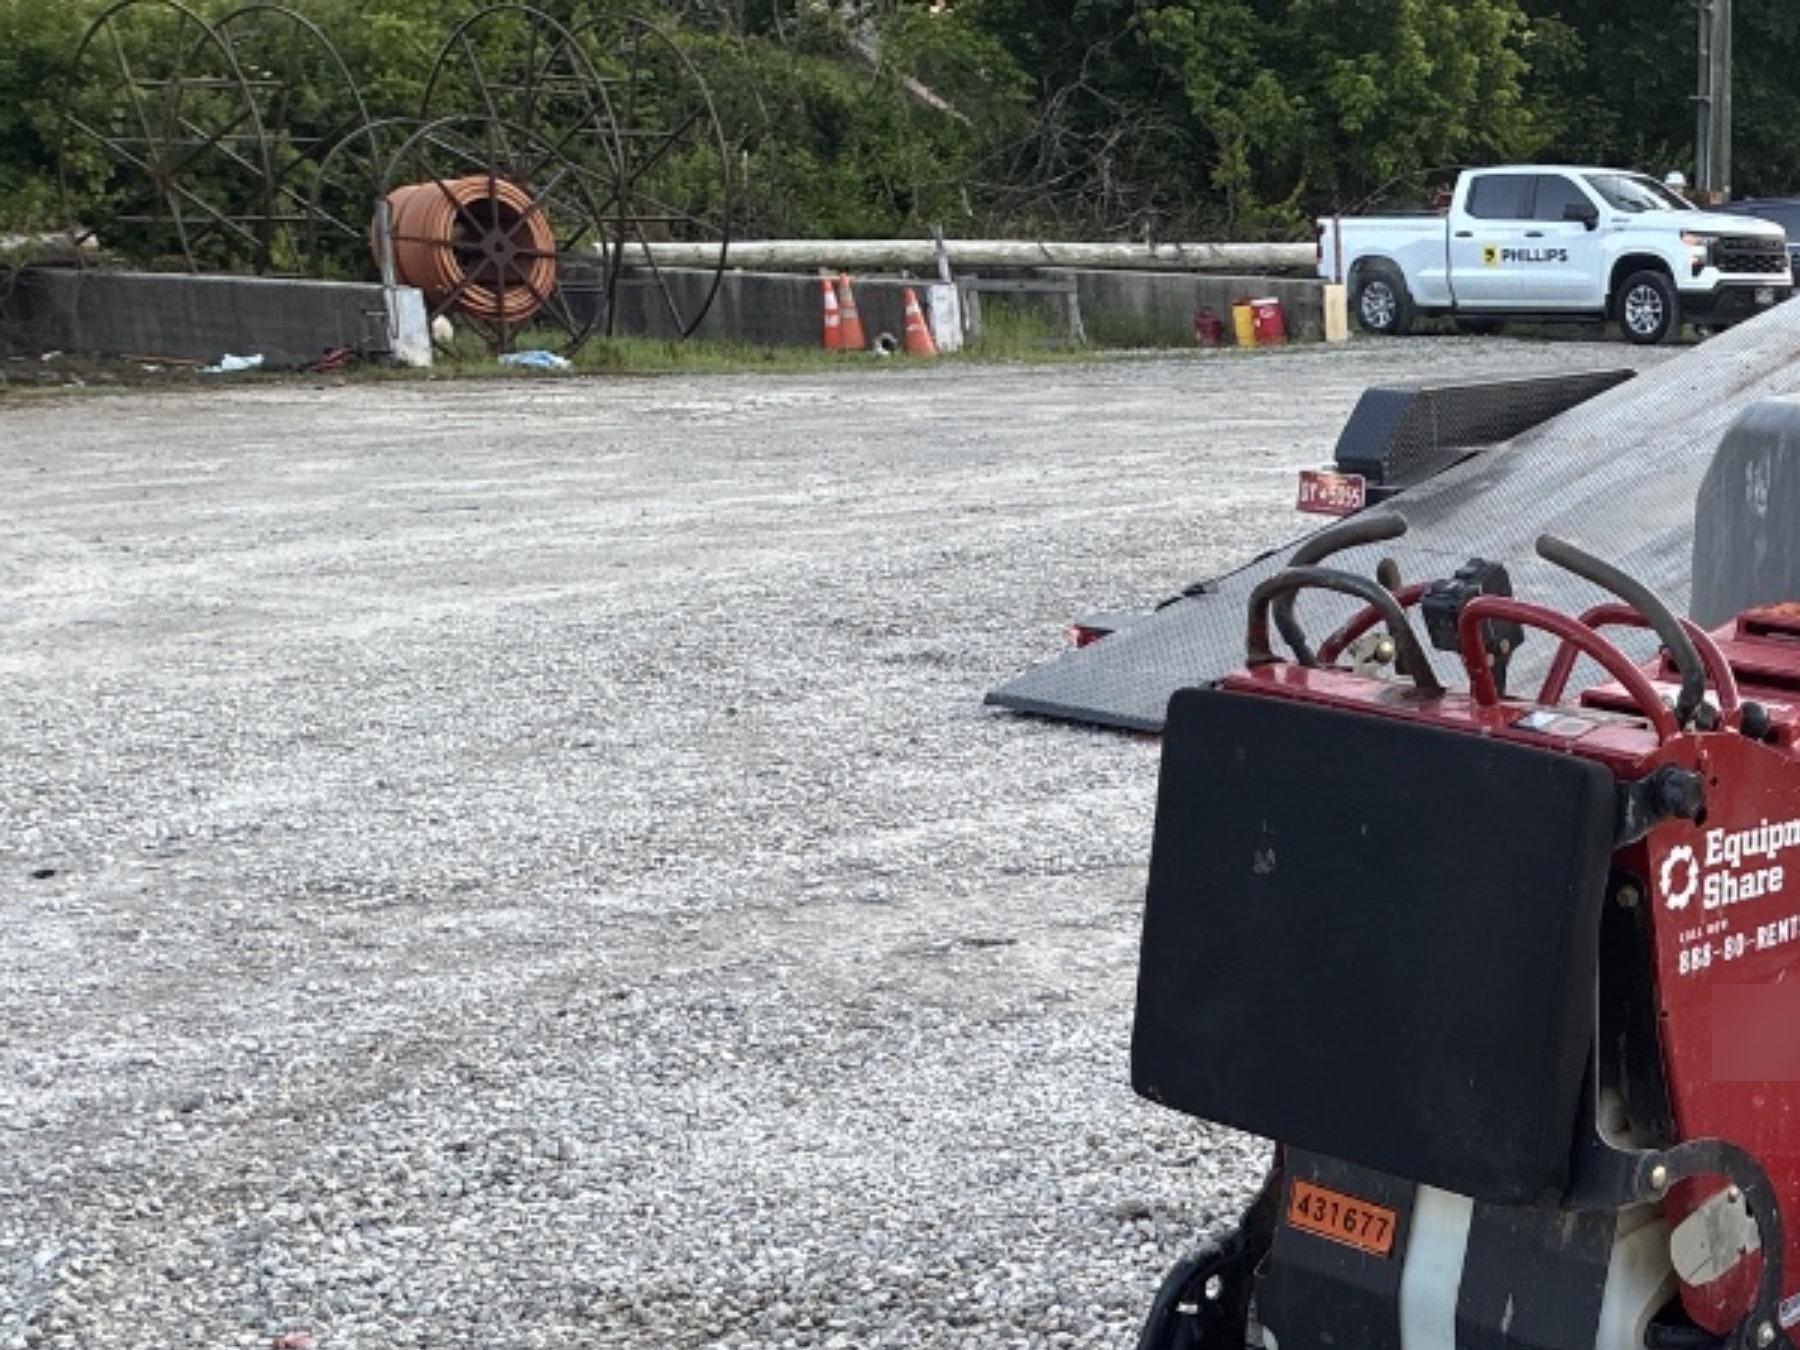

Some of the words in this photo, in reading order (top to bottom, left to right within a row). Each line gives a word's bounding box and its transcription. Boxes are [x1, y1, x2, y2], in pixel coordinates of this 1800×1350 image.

[1502, 247, 1568, 262] PHILLIPS
[1703, 866, 1784, 910] Share
[1297, 1193, 1390, 1243] 431677
